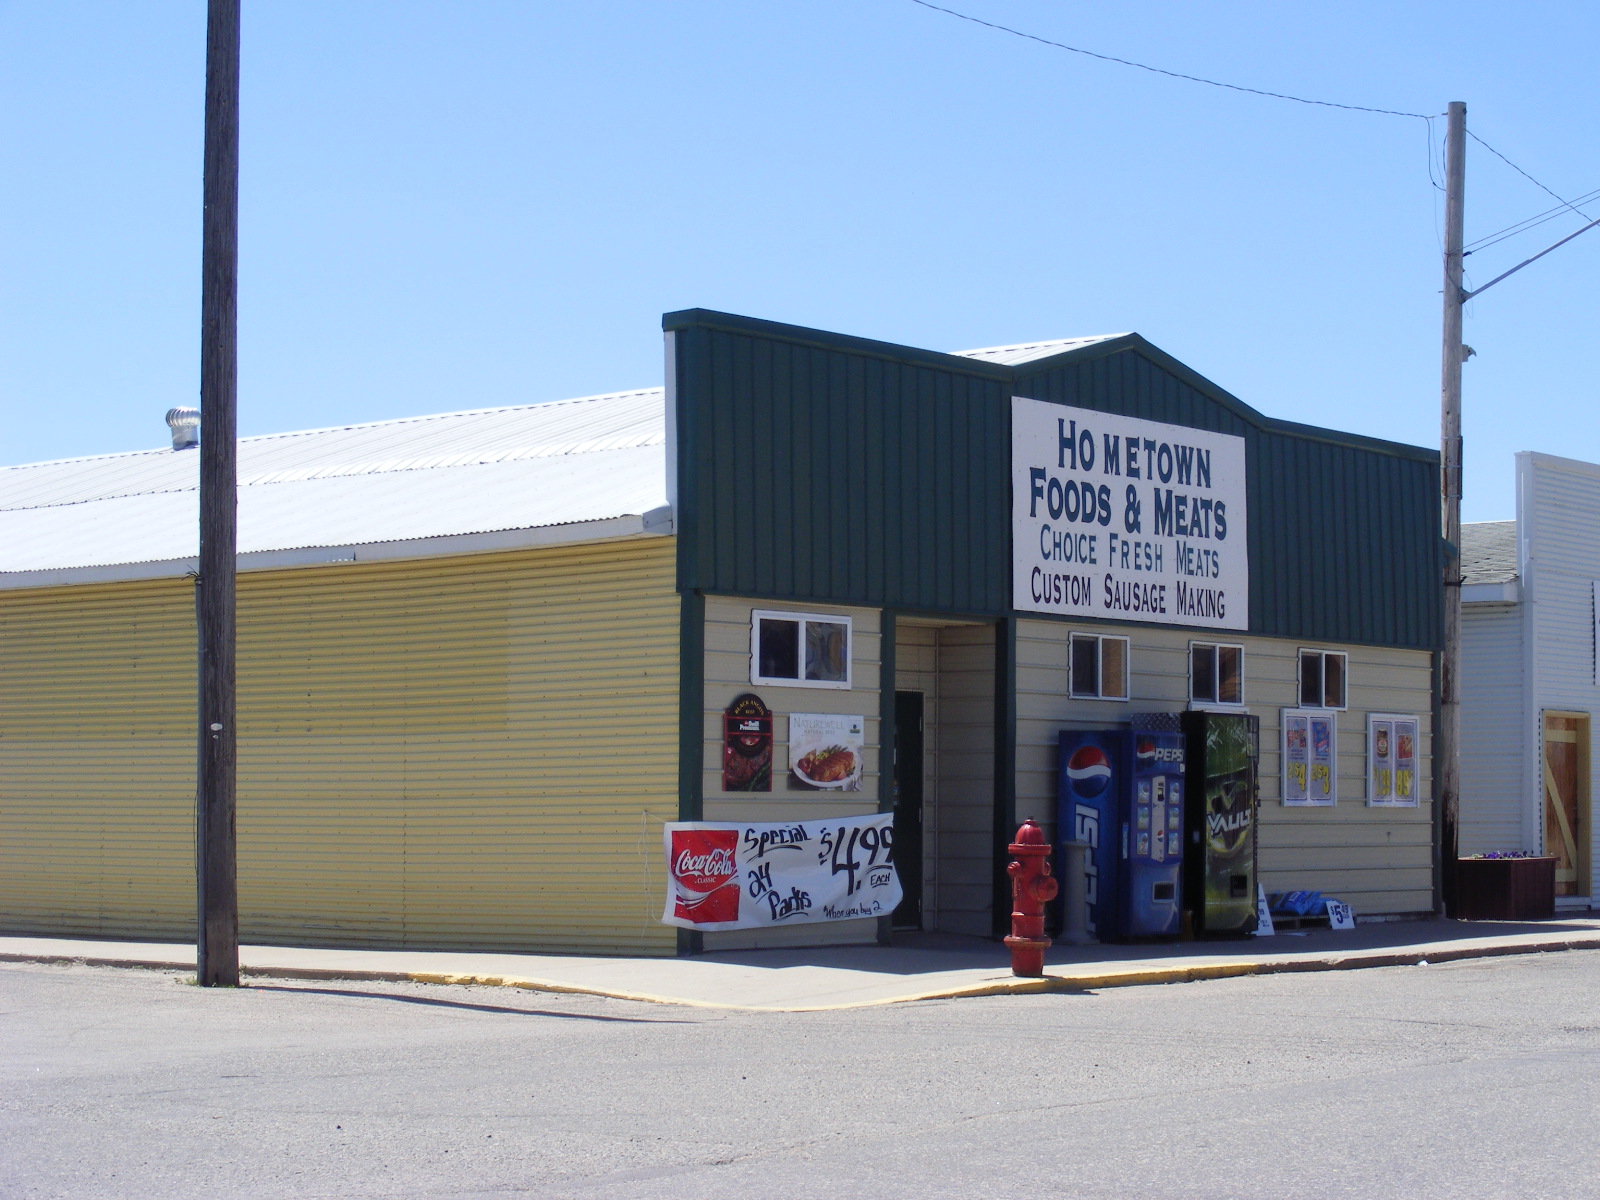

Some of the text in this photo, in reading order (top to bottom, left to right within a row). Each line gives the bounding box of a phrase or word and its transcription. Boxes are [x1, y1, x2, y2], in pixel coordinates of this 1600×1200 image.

[1058, 417, 1212, 488] HOMETOWN
[1029, 466, 1227, 541] FOODS & MEATS
[1040, 523, 1219, 579] CHOICE FRESH MEATS
[1031, 566, 1226, 619] CUSTOM SAUSAGE MAKING
[1207, 808, 1251, 836] VAULT
[742, 824, 813, 858] Special
[675, 848, 734, 877] Coca-Cola
[748, 861, 772, 898] 24
[870, 873, 890, 886] EACH
[844, 907, 858, 918] you
[873, 900, 883, 911] 2
